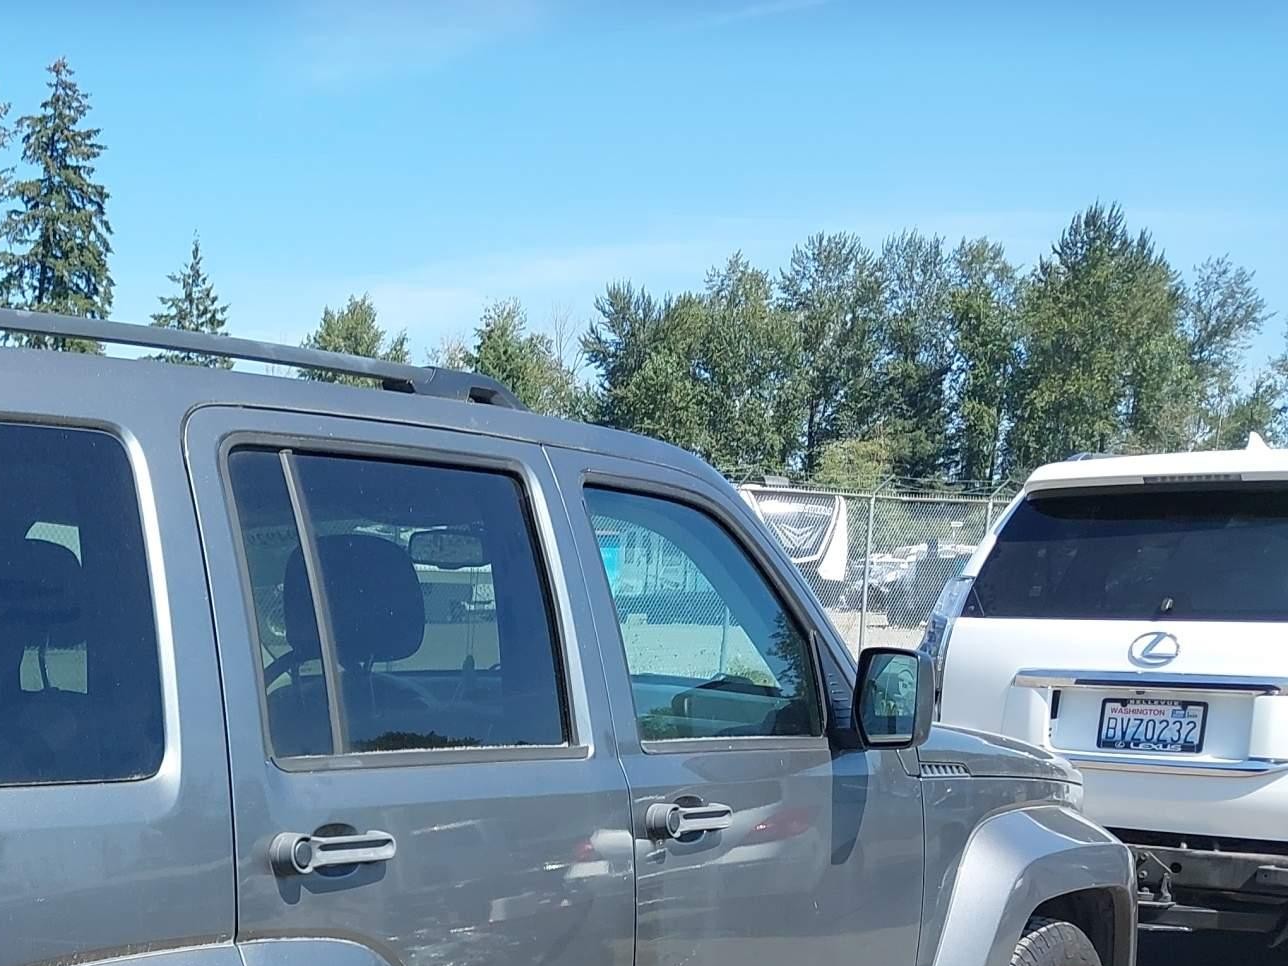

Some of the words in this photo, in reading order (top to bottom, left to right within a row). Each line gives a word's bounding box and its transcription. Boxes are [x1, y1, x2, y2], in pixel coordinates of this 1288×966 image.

[1111, 707, 1166, 717] WASHINGTON
[1105, 716, 1197, 745] BVZ0232
[1130, 742, 1182, 752] LEXUS
